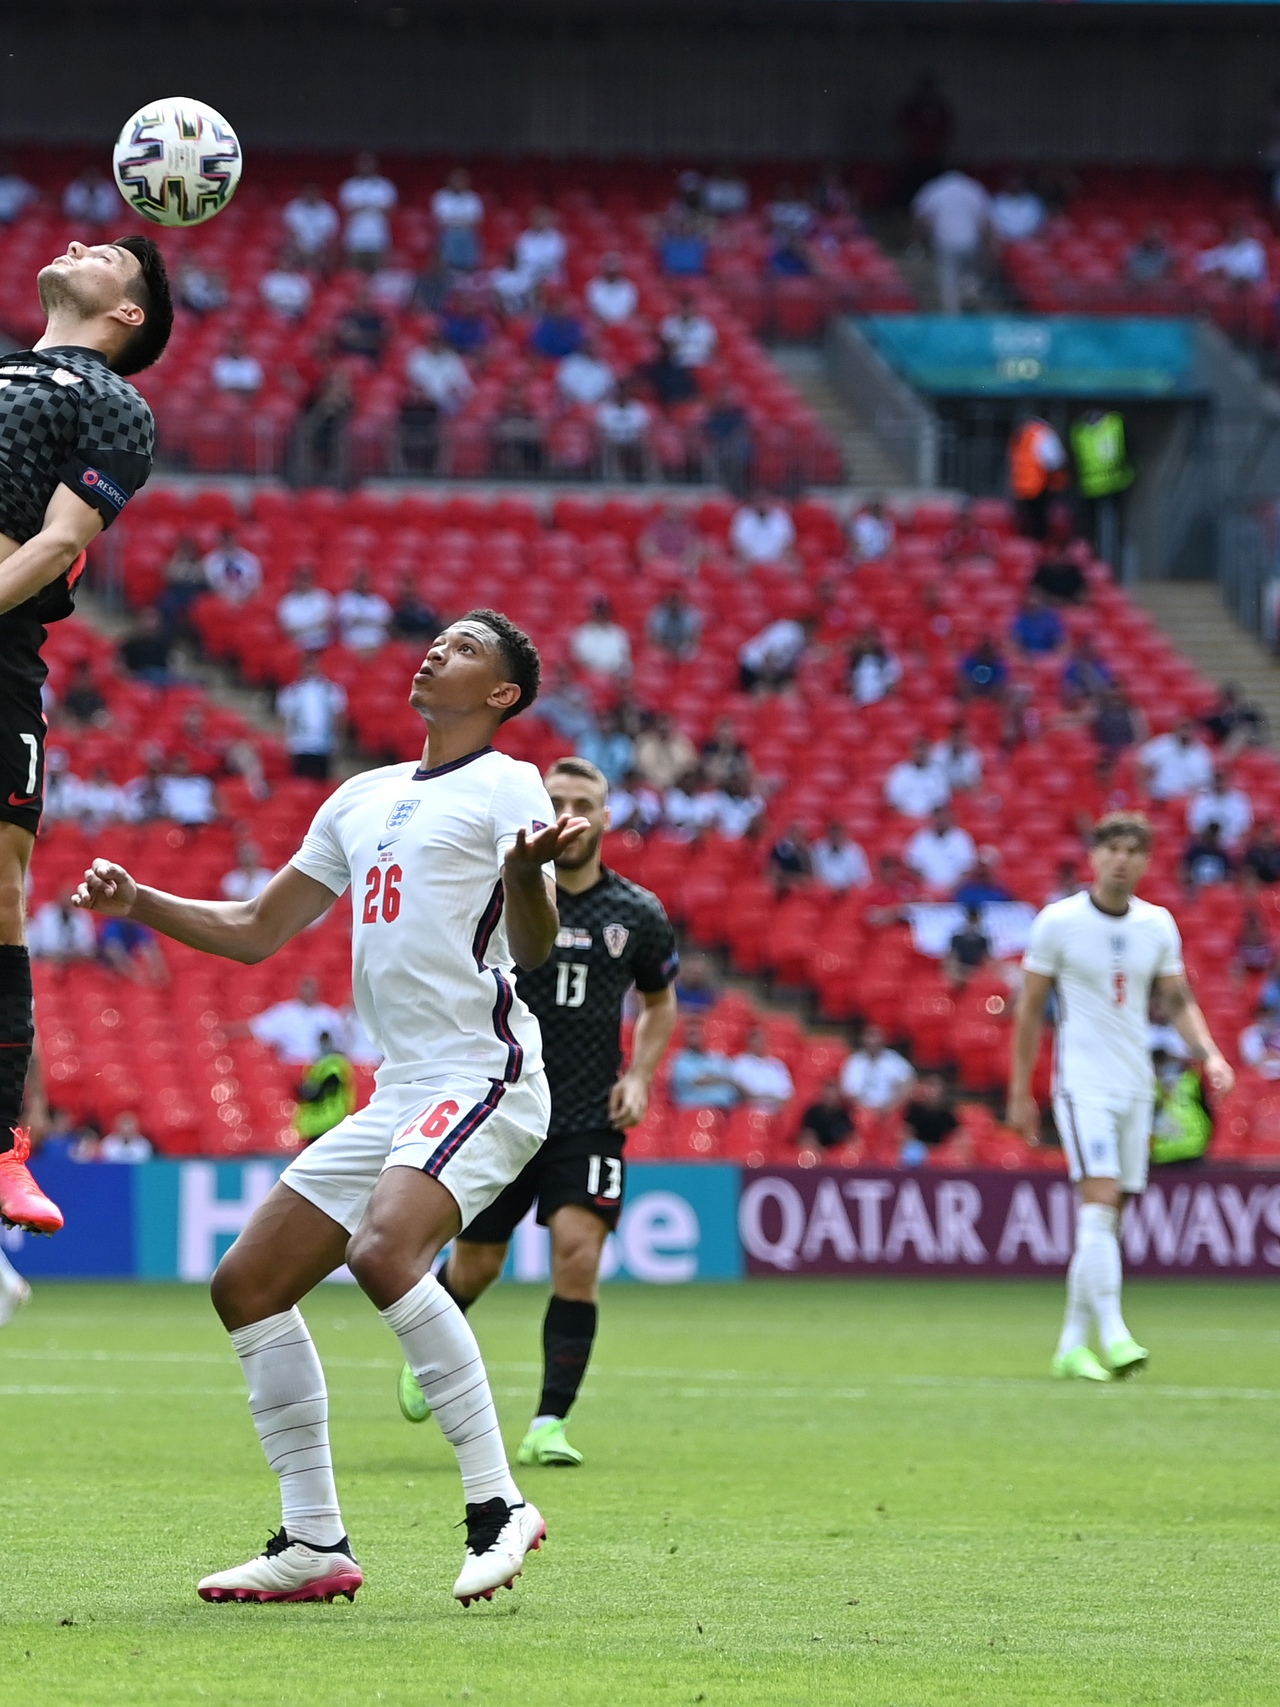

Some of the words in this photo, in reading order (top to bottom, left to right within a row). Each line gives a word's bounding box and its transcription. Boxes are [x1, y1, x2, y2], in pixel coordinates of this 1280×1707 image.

[96, 479, 127, 507] RESPECT
[361, 863, 403, 925] 26
[555, 961, 589, 1008] 13
[586, 1154, 622, 1200] 13
[738, 1177, 990, 1270] QATAR
